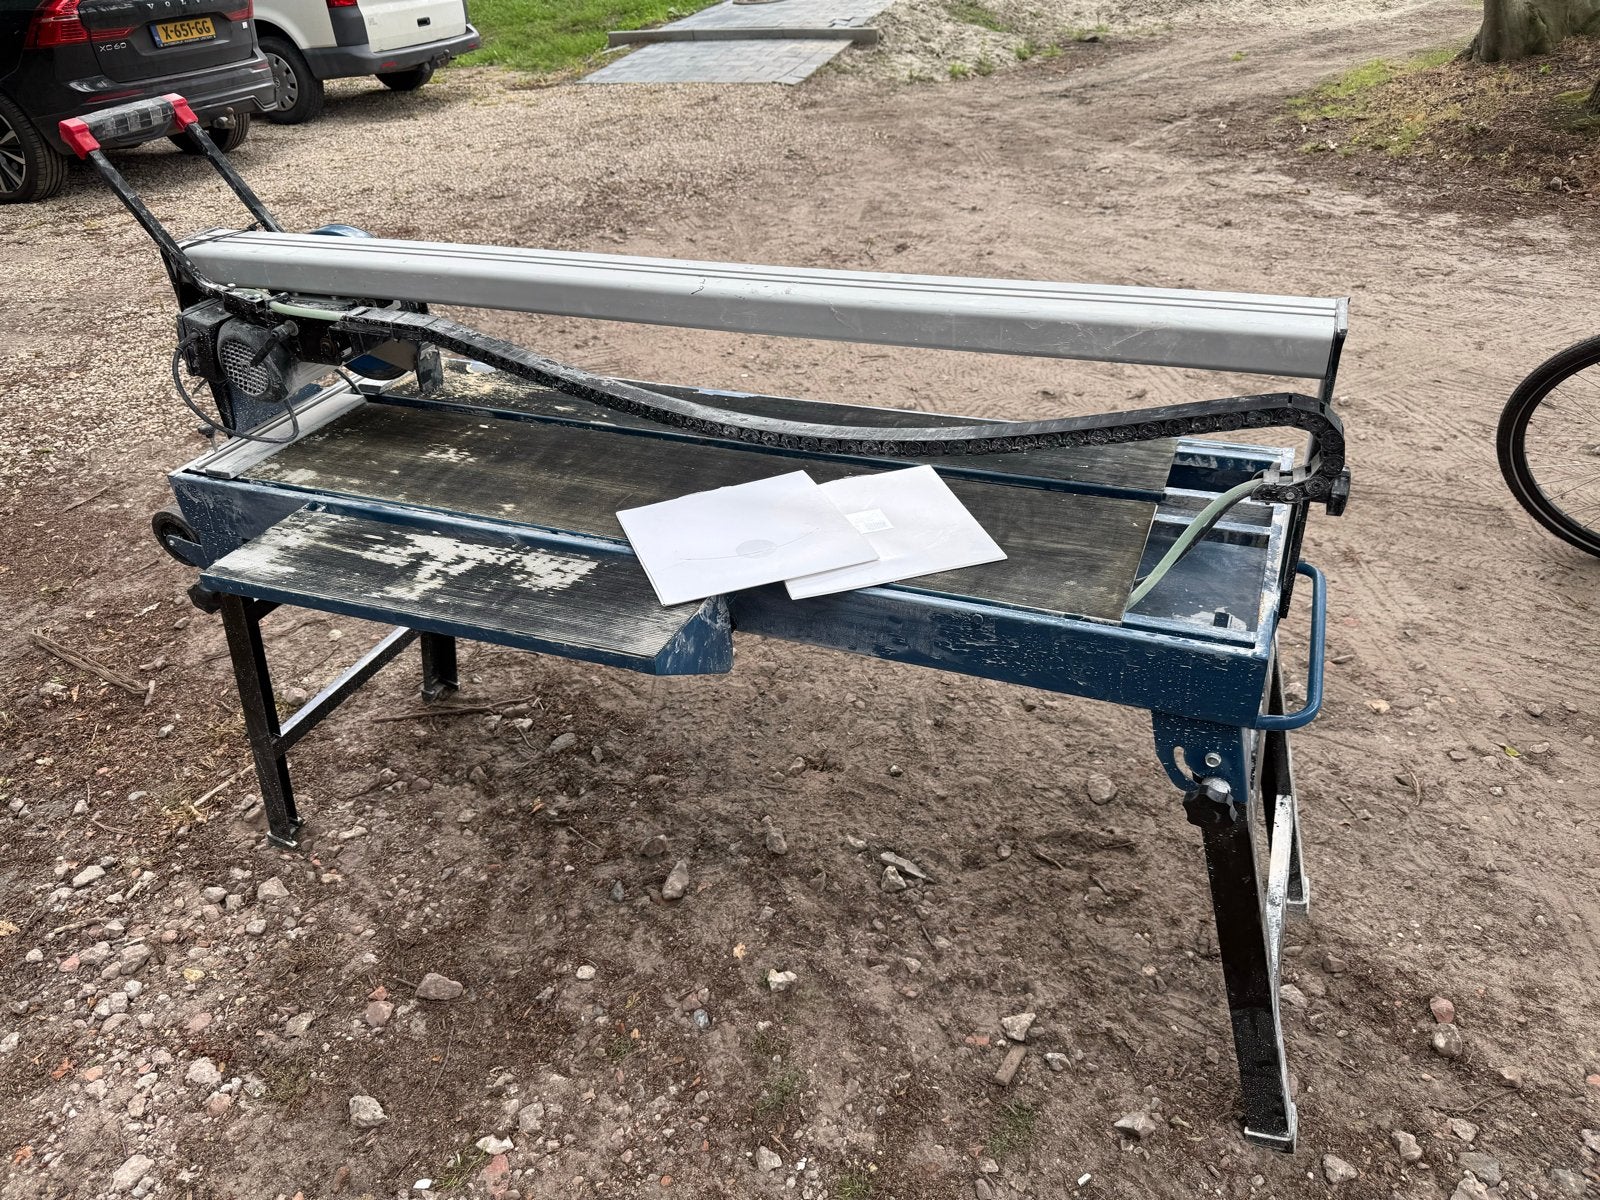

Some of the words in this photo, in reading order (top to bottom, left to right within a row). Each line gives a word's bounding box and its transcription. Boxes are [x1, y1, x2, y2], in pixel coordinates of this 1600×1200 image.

[147, 0, 214, 9] VOL
[161, 20, 211, 40] X-651-GG
[99, 42, 127, 52] XC60
